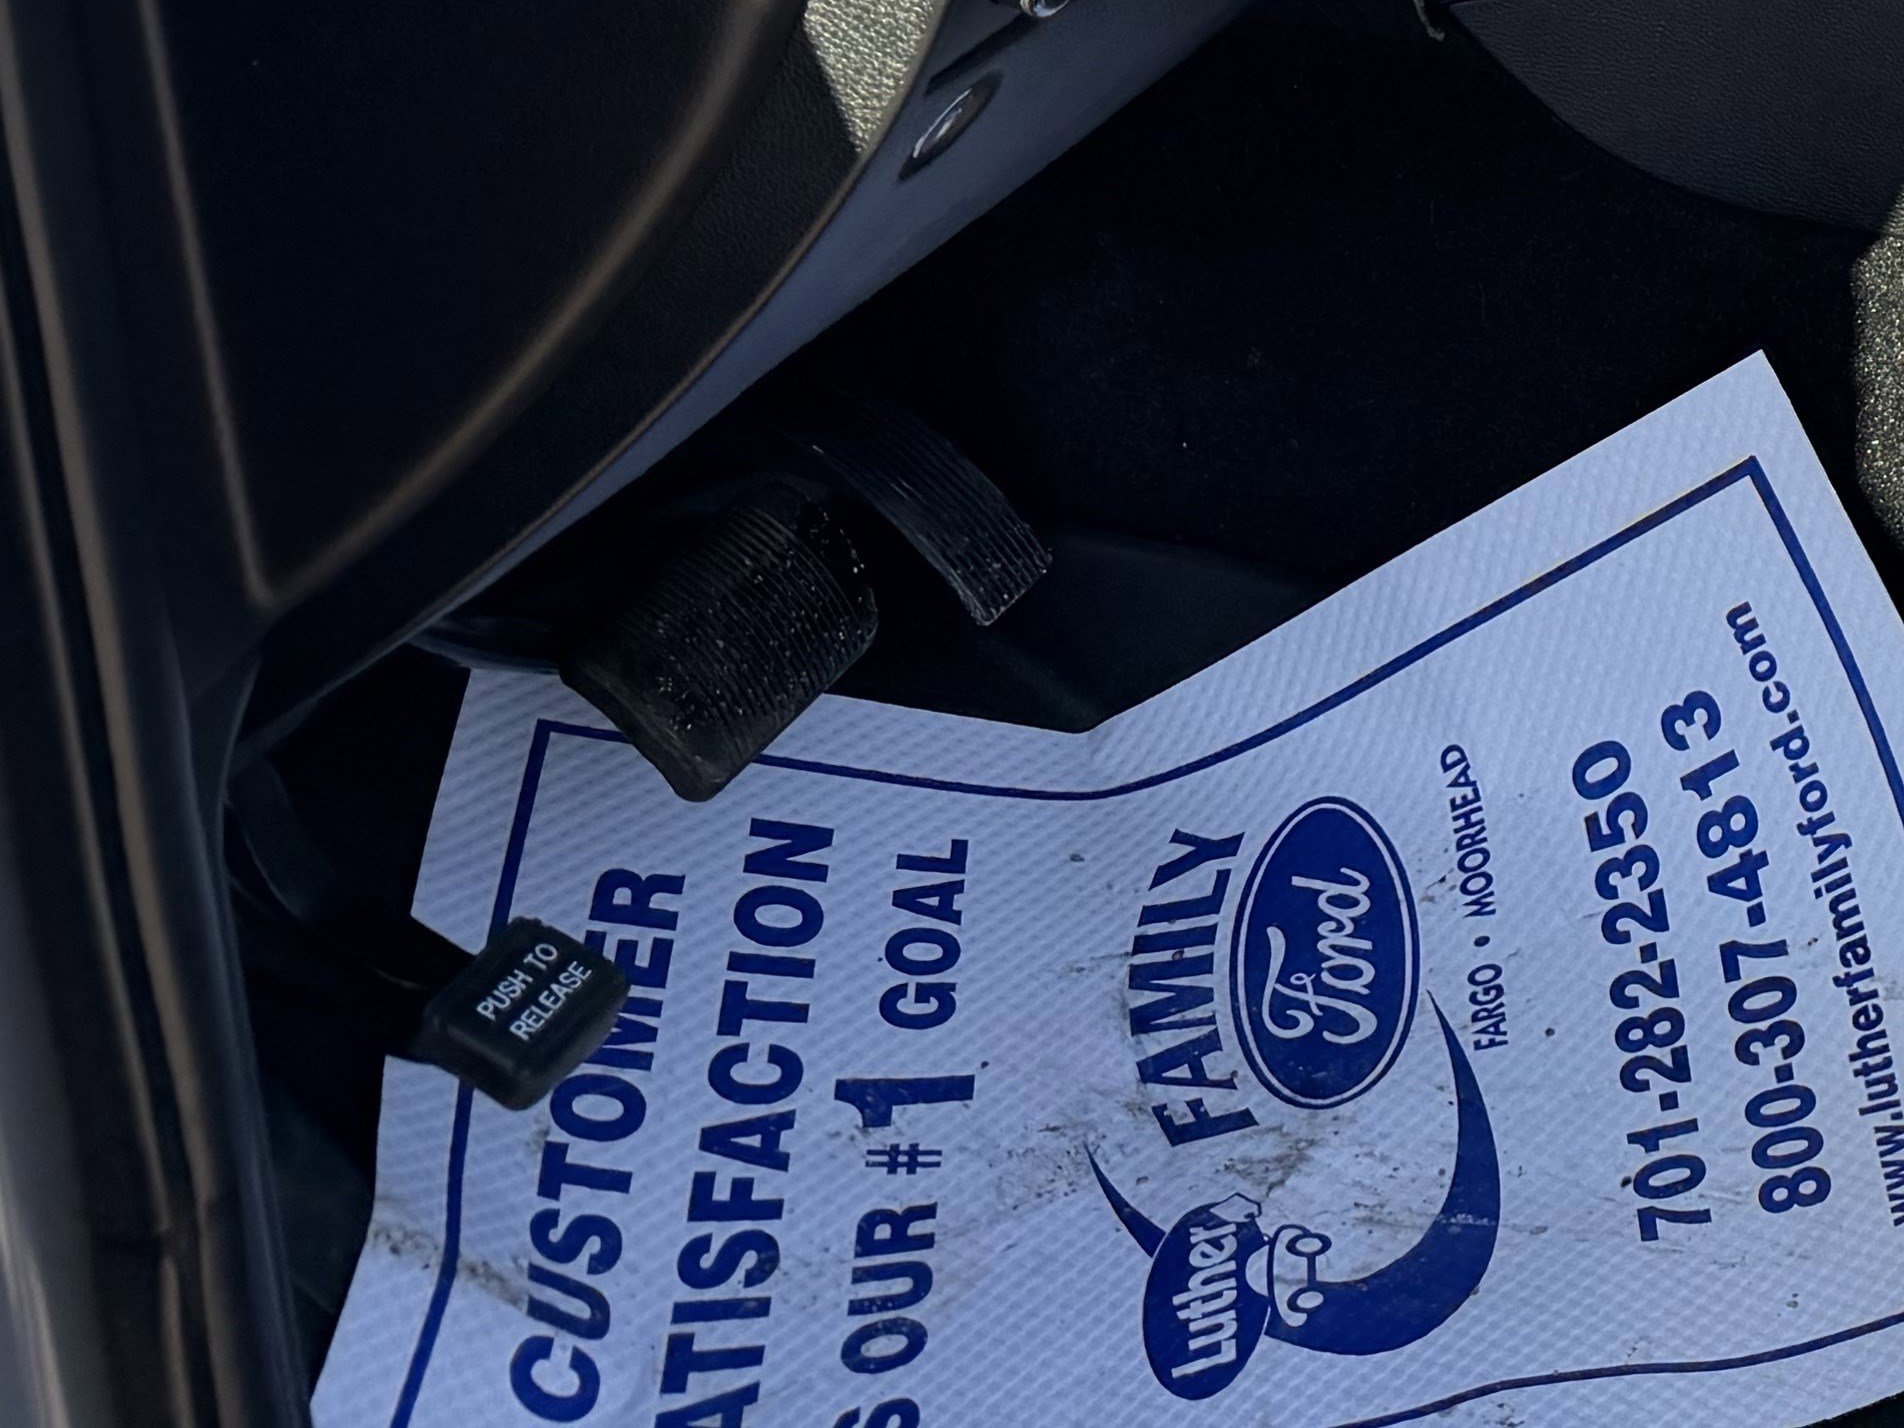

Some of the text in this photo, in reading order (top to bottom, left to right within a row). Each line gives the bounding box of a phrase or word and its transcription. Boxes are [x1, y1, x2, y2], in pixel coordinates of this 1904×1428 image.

[476, 943, 558, 1021] PUSH TO
[878, 839, 969, 1030] GOAL
[1128, 829, 1259, 1147] FAMILY
[1262, 867, 1379, 1044] Ford
[1440, 744, 1509, 1051] FARGO MOORHEAD
[1571, 740, 1712, 1242] 701-282-2350
[1661, 690, 1832, 1214] 800-307-4813
[509, 960, 592, 1041] RELEASE
[655, 818, 835, 1428] ATISFACTION
[840, 1201, 939, 1375] OUR
[1172, 1222, 1238, 1379] Luther
